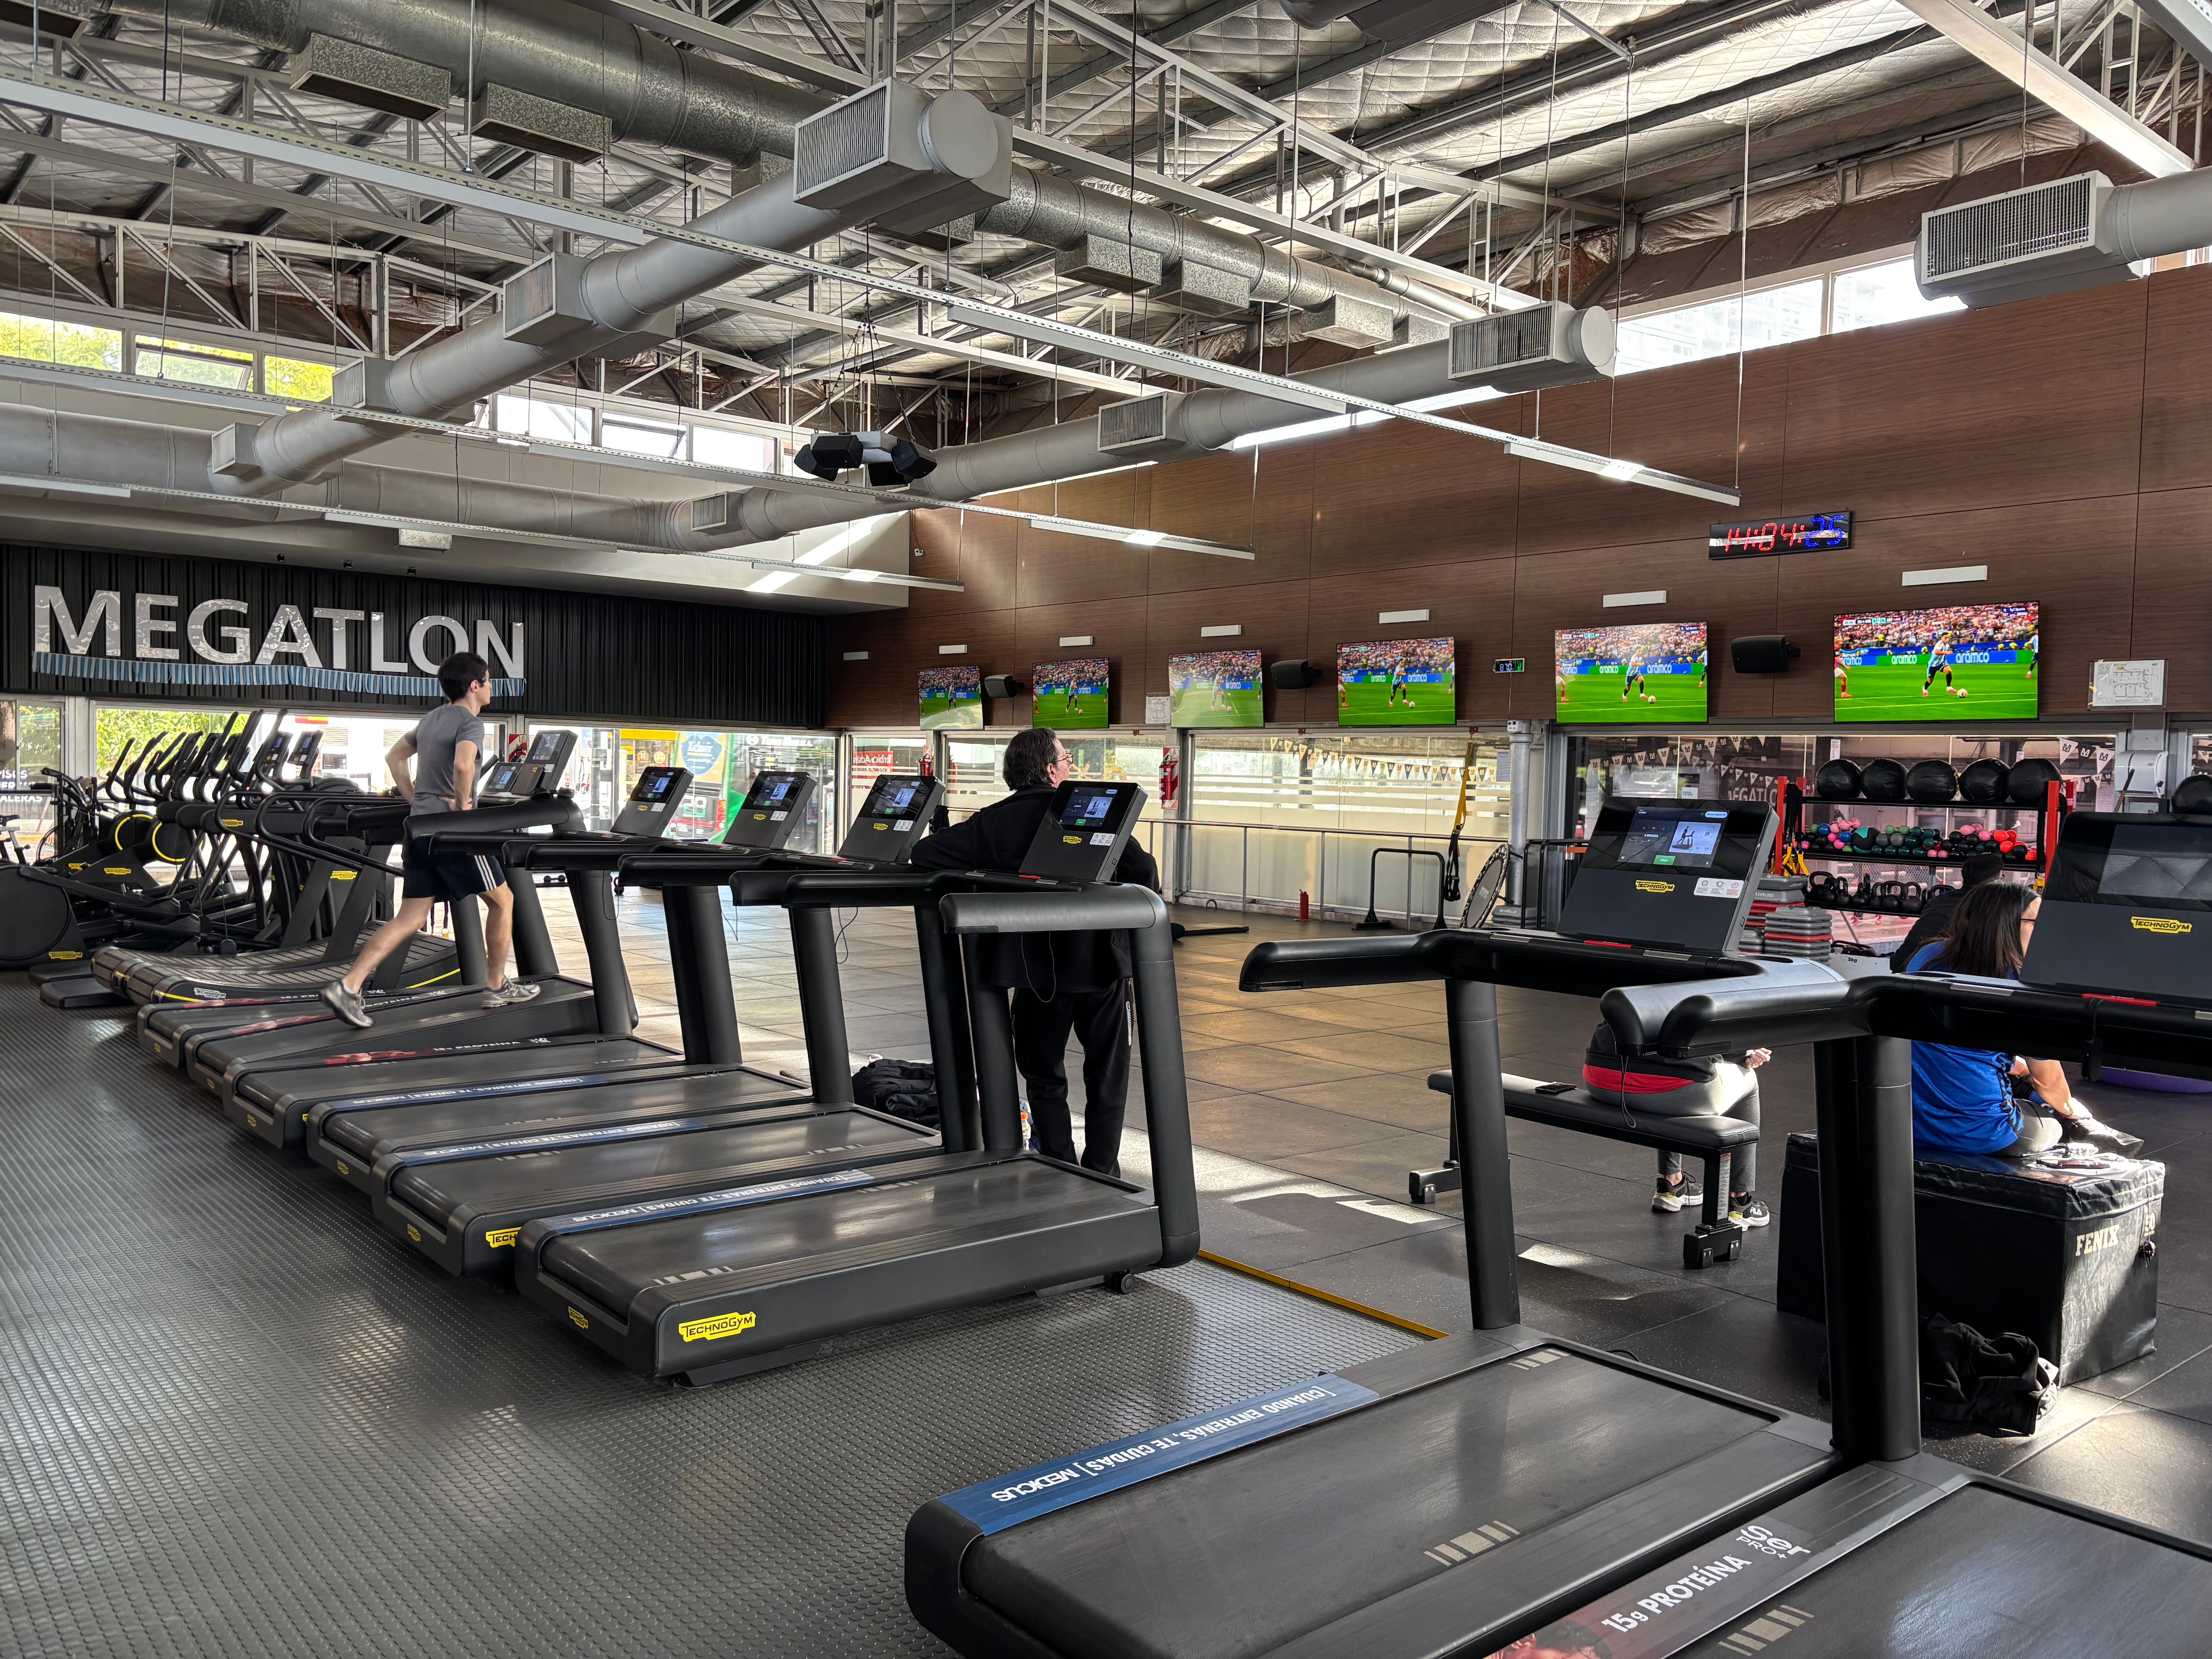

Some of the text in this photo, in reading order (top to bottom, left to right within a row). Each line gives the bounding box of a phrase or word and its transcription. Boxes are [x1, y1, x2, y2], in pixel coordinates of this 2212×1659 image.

[35, 584, 524, 679] MEGATLON
[1891, 655, 1917, 664] aramco
[1956, 652, 1990, 663] aramco
[1599, 665, 1619, 674] aramco
[1647, 664, 1672, 674] aramco
[1637, 881, 1674, 890] TECHNOGYM
[2132, 918, 2190, 931] TECHNOGYM
[424, 1145, 484, 1156] MEDICUS
[572, 1208, 637, 1222] MEDICUS
[2075, 1224, 2120, 1257] FENIX
[681, 1314, 754, 1337] TECHNOGYM
[991, 1385, 1338, 1502] [CUANDO ENTRENÁS, TE CUIDÁS] MEDICUS
[1740, 1525, 1812, 1555] Ser
[1736, 1536, 1787, 1559] PRO+
[1601, 1555, 1752, 1632] 15g PROTEÍNA
